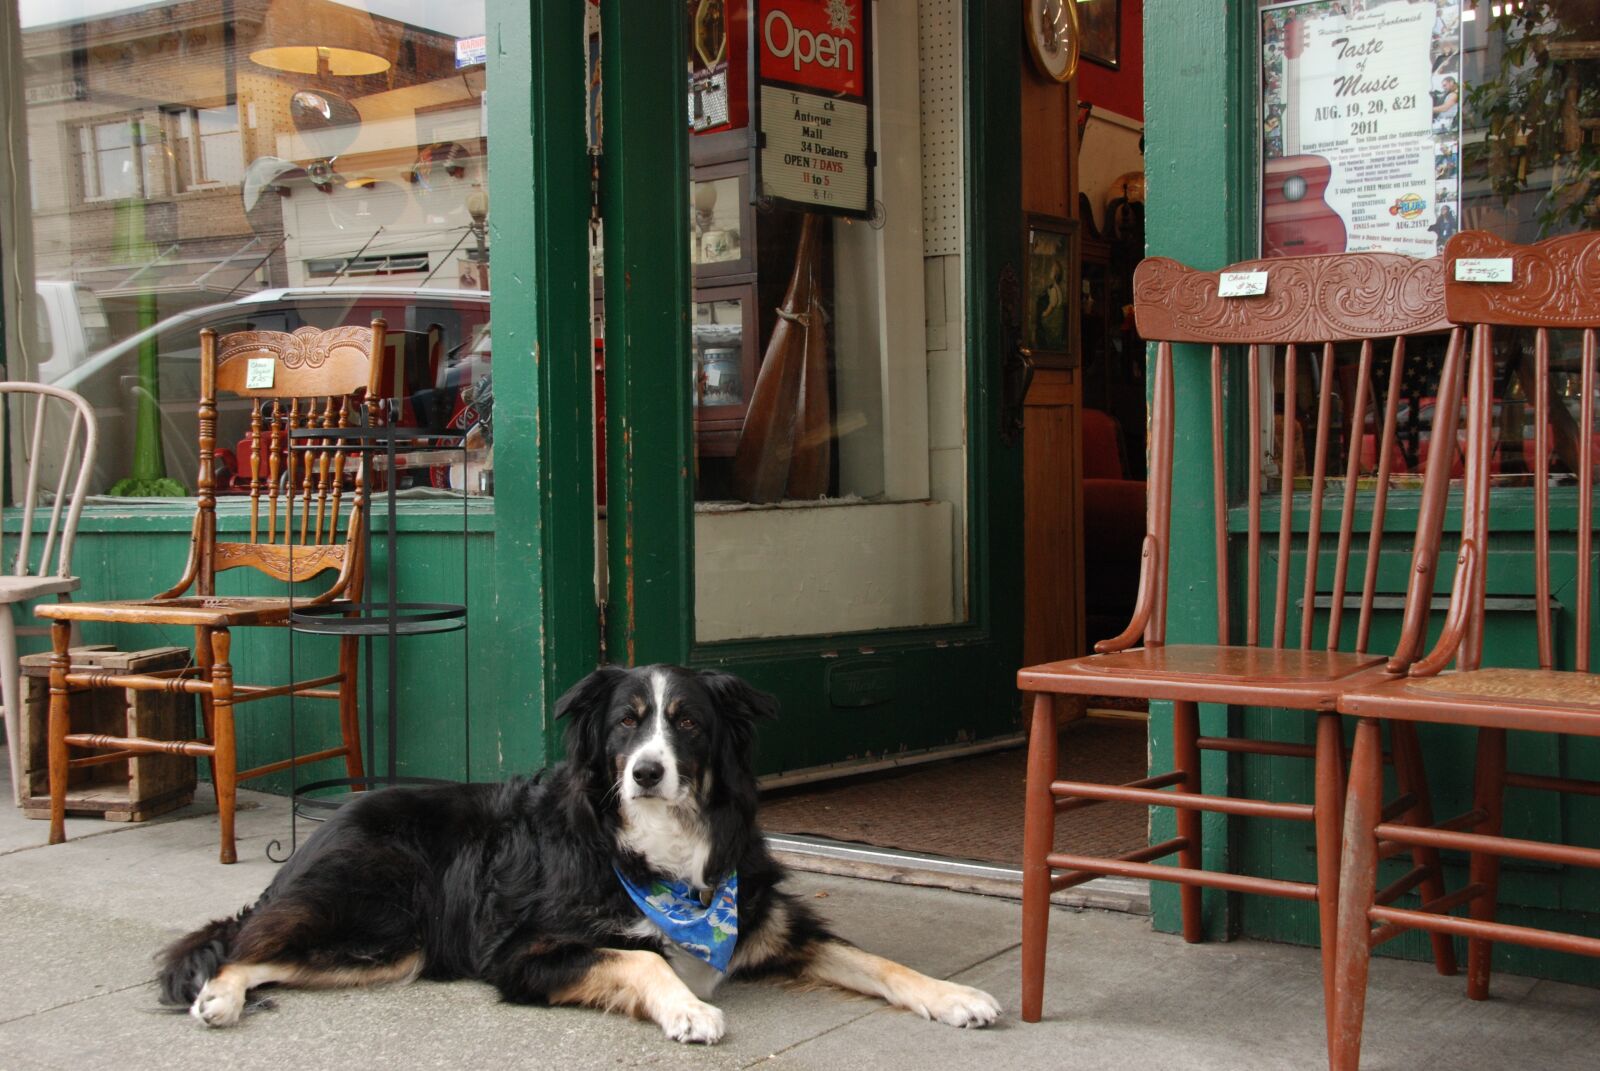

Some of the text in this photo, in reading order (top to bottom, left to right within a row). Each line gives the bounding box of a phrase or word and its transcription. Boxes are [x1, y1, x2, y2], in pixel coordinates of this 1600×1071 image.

[764, 9, 854, 72] Open
[1331, 37, 1384, 60] Taste
[1355, 57, 1368, 72] of
[1333, 74, 1399, 98] Music
[1314, 94, 1417, 121] AUG. 19, 20, &21
[794, 109, 832, 127] Antique
[802, 126, 823, 140] Mall
[1350, 119, 1379, 136] 2011
[801, 141, 849, 160] 34 Dealers
[784, 153, 844, 173] OPEN 7 DAYS
[803, 172, 830, 187] 11 to 5
[1351, 198, 1387, 208] INTERNATIONAL
